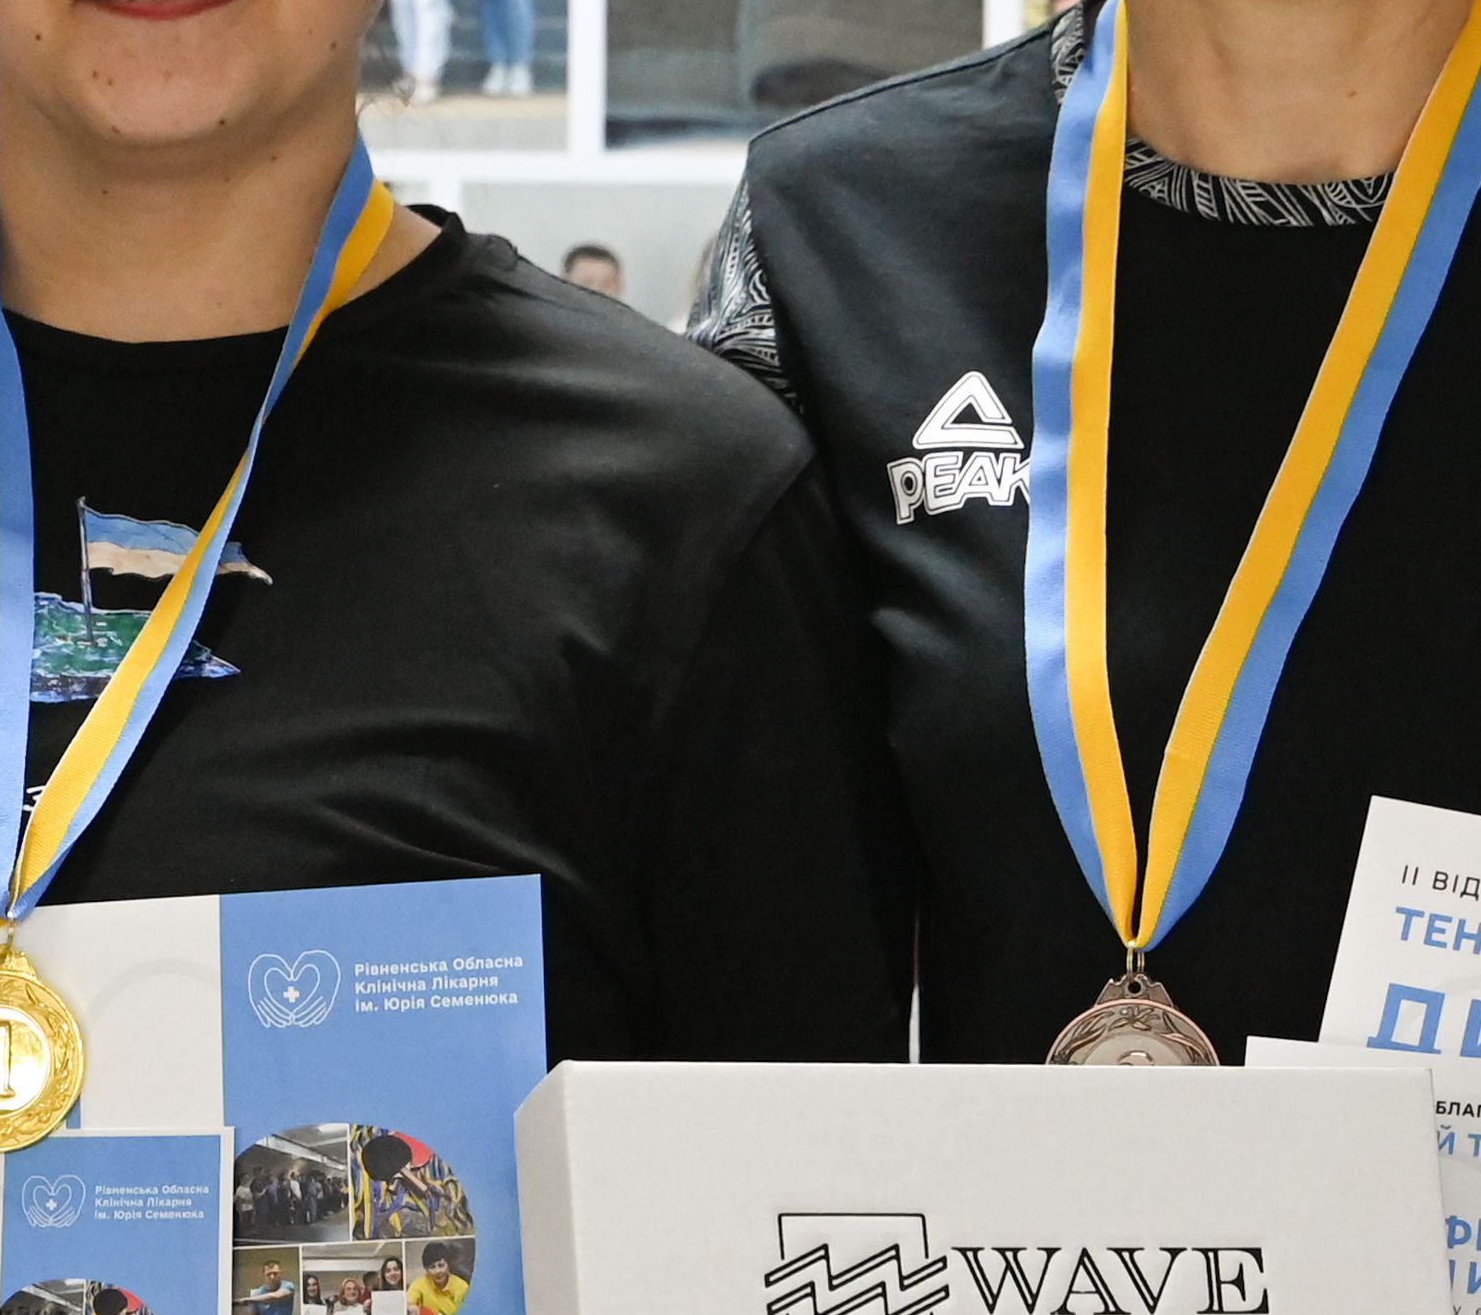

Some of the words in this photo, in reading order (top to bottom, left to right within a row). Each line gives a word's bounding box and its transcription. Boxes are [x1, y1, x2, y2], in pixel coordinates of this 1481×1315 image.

[886, 451, 1031, 525] PEAK
[355, 960, 448, 976] Рівненська
[453, 956, 523, 971] Обласна
[355, 979, 426, 995] Клінічна
[432, 976, 498, 990] Лікарня
[355, 999, 379, 1012] ім.
[384, 996, 425, 1012] Юрія
[430, 992, 518, 1008] Семенюка
[95, 1185, 158, 1195] Рівненська
[162, 1185, 209, 1194] Обласна
[95, 1197, 143, 1207] Клінічна
[147, 1197, 192, 1208] Лікарня
[114, 1210, 141, 1221] Юрія
[145, 1210, 204, 1219] Семенюка
[951, 1246, 1269, 1315] WAVE
